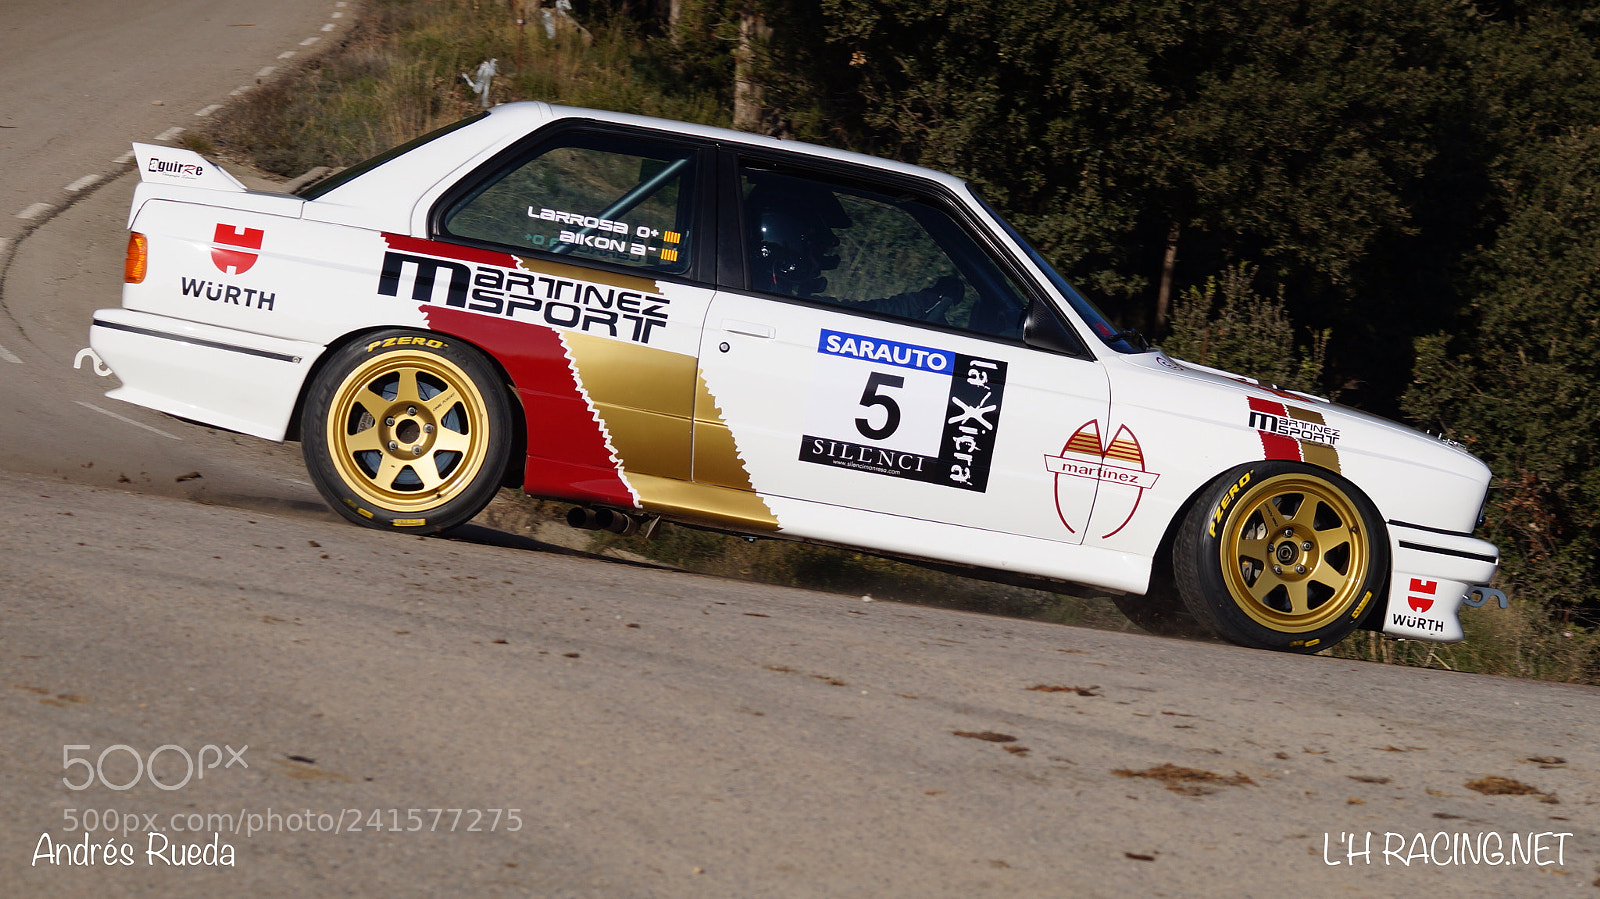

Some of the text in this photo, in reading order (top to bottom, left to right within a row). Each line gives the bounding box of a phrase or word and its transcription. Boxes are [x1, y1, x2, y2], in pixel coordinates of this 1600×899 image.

[181, 276, 276, 311] WÜRTH
[468, 288, 668, 345] SPORT
[826, 334, 947, 371] SARAUTO
[854, 371, 905, 440] 5
[1278, 426, 1340, 445] SPORT
[812, 439, 925, 472] SILENCI
[1392, 613, 1444, 633] WÜRTH
